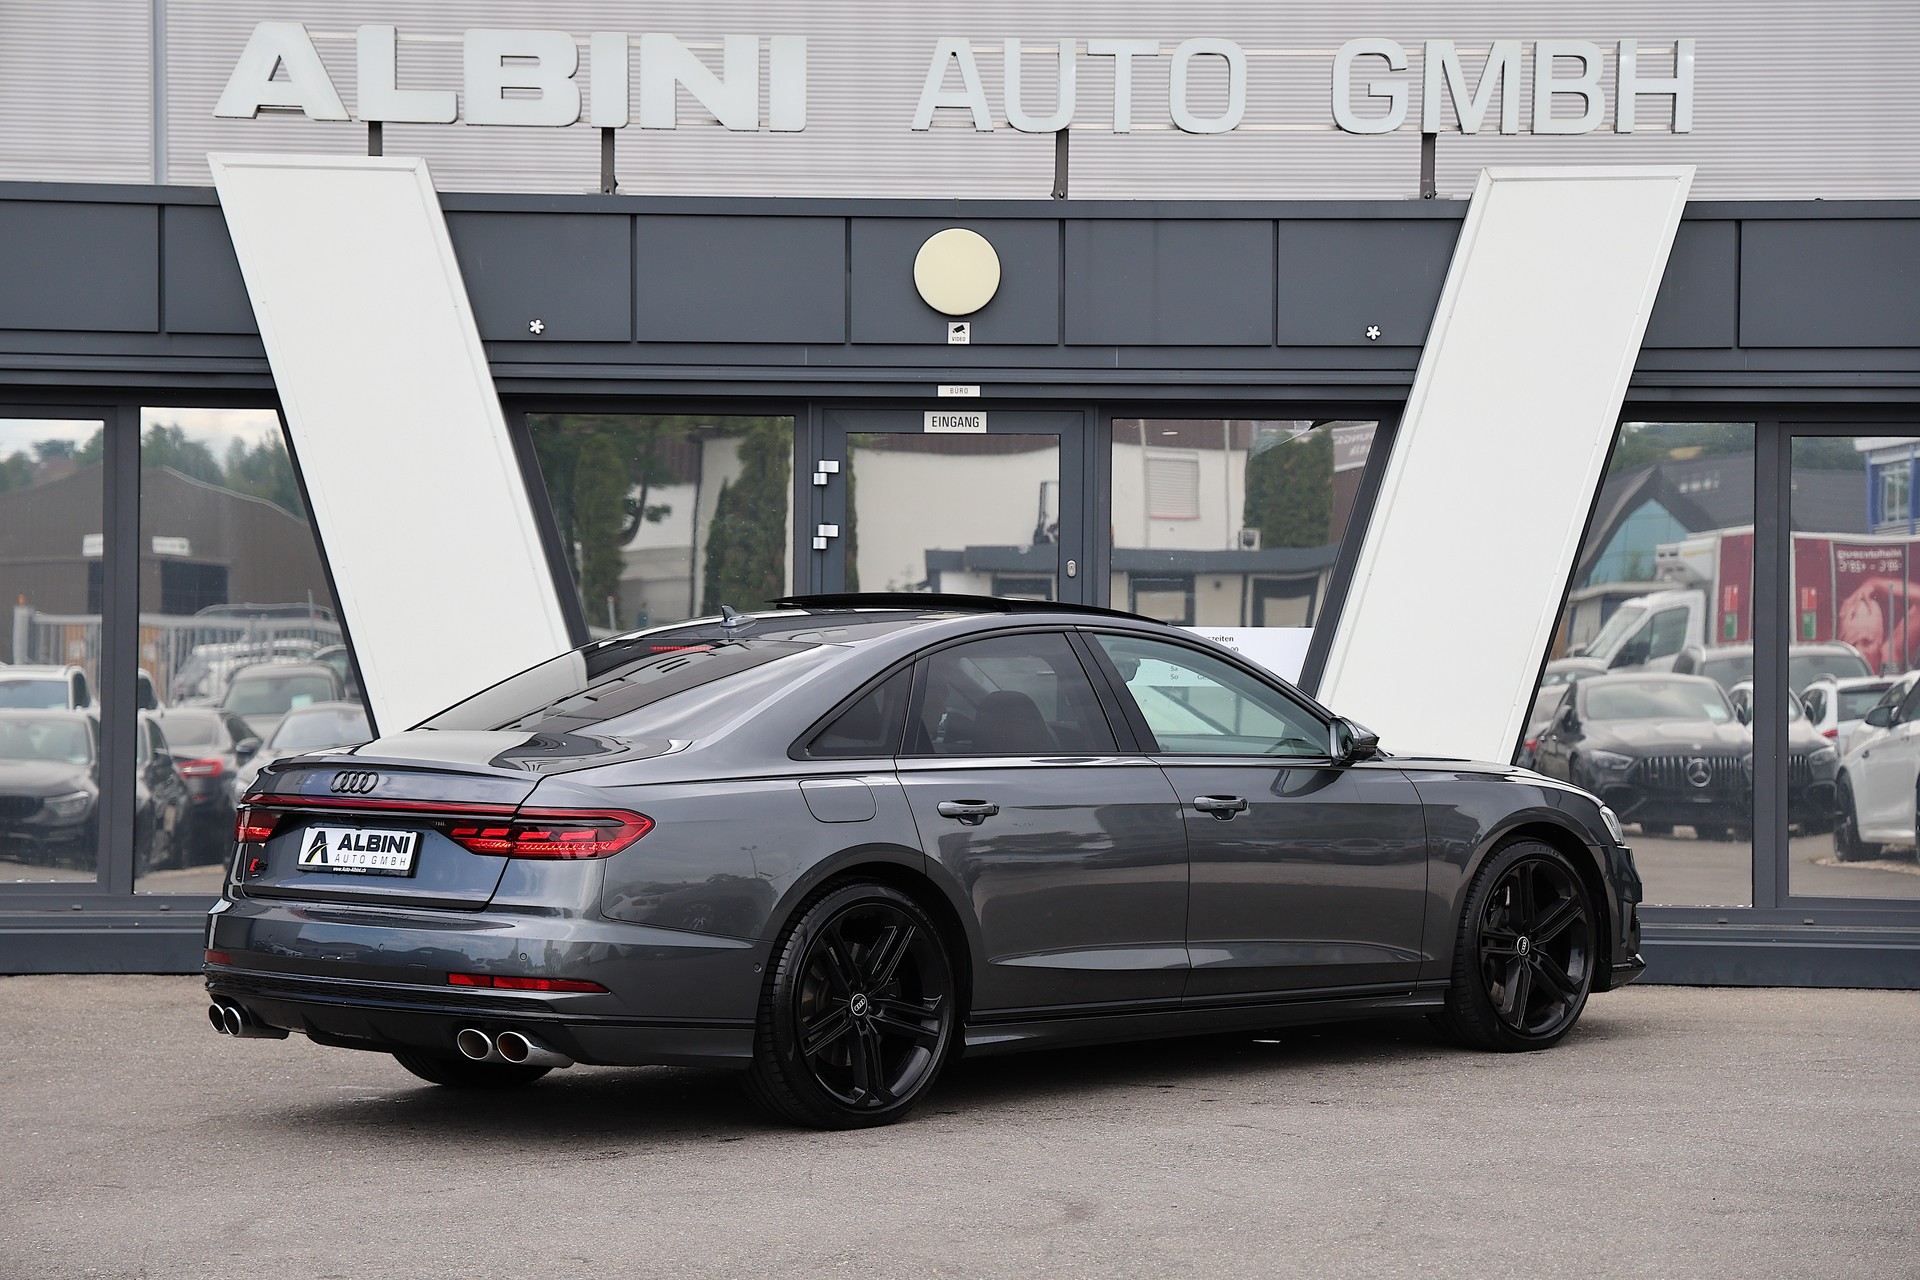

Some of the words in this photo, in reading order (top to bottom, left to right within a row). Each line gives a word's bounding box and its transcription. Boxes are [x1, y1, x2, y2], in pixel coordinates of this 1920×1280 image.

[213, 21, 807, 132] ALBINI
[911, 36, 1247, 134] AUTO
[1331, 37, 1696, 136] GMBH
[931, 416, 980, 428] EINGANG
[337, 833, 411, 854] ALBINI
[334, 853, 366, 864] AUTO
[371, 855, 408, 867] GMBH
